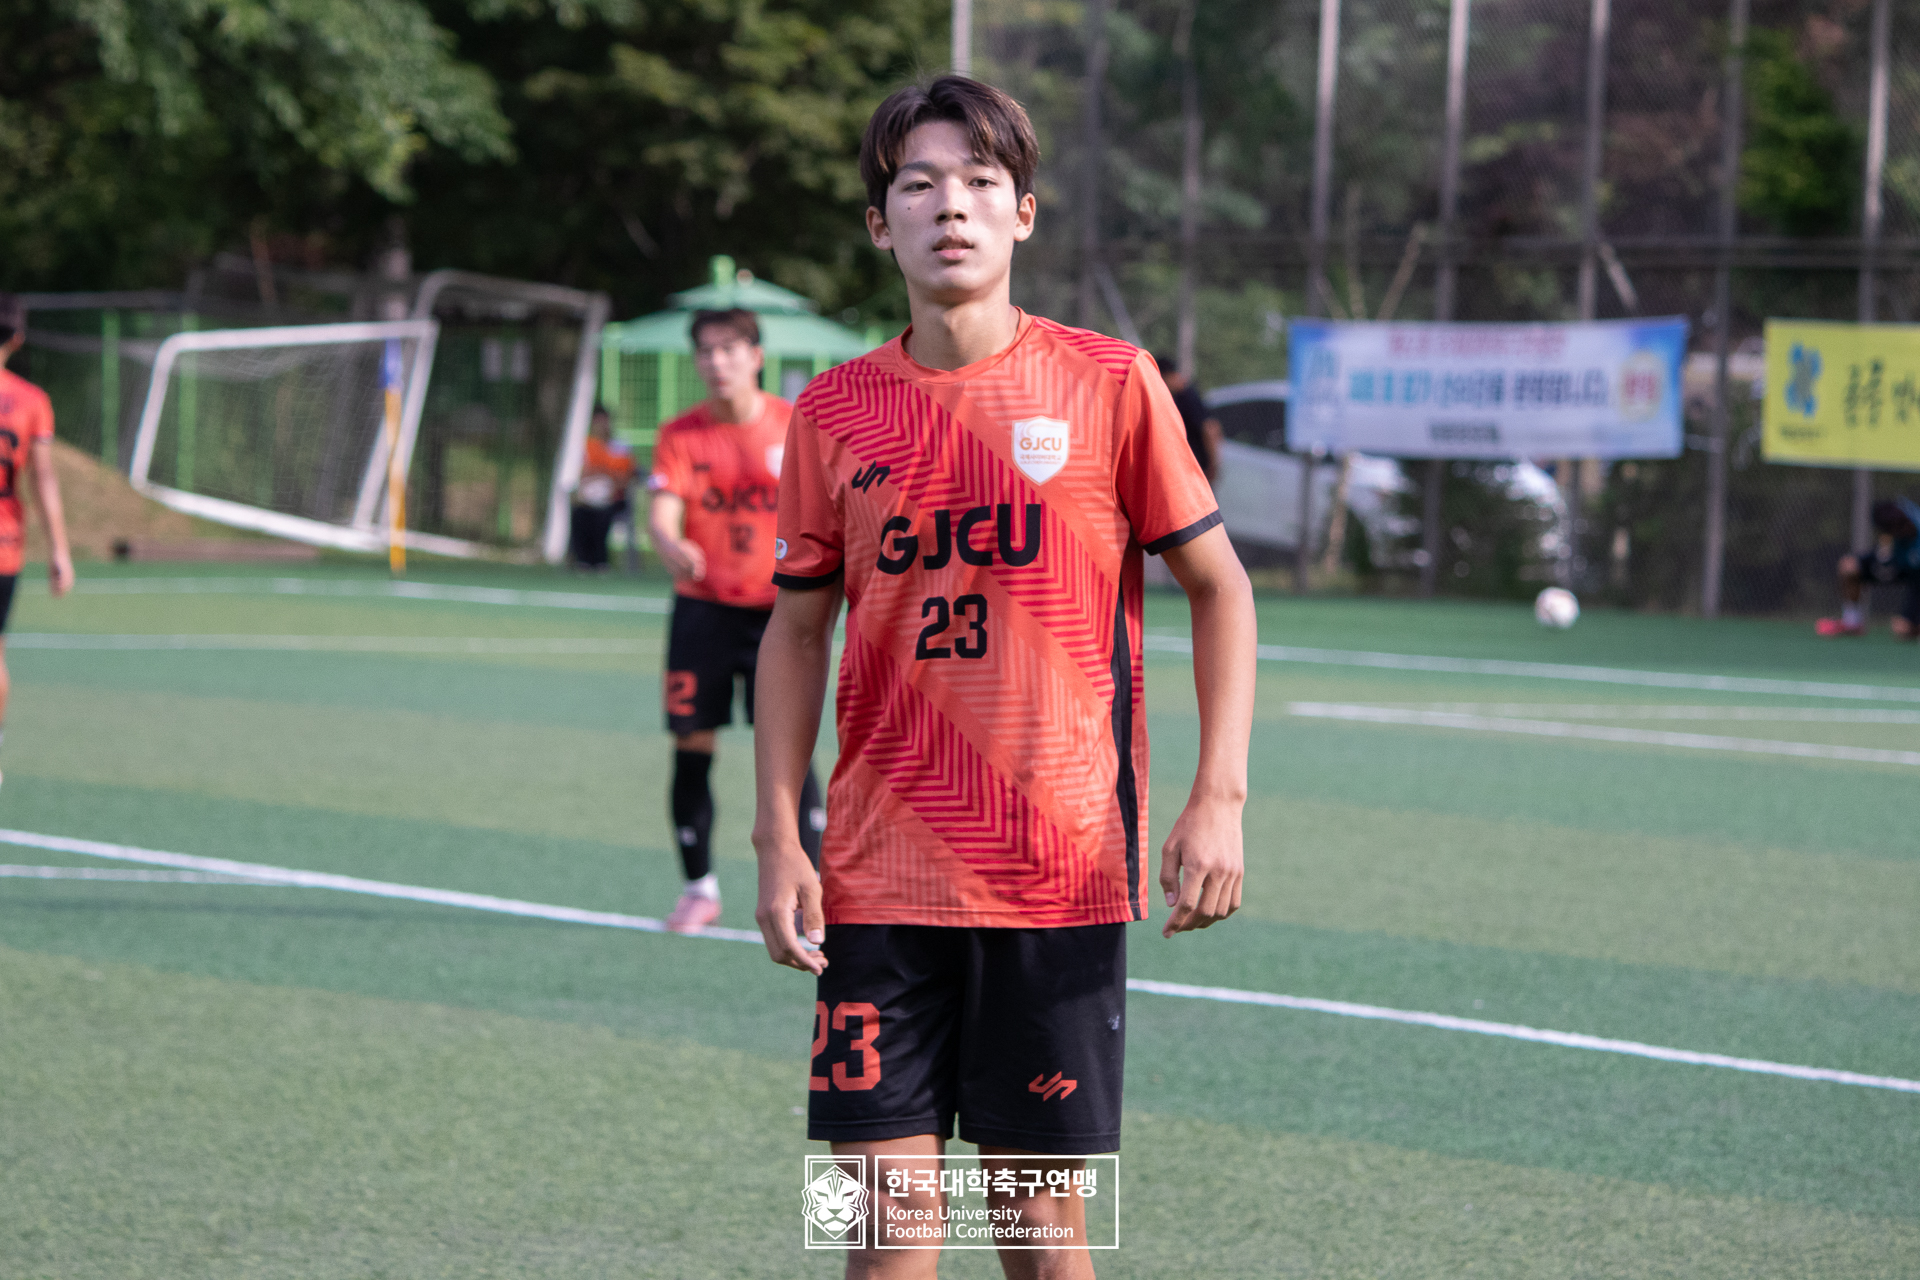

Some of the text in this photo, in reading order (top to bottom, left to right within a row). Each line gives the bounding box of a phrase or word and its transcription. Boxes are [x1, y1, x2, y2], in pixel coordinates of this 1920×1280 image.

[1020, 437, 1062, 451] GJCU
[876, 503, 1041, 575] GJCU
[915, 594, 988, 661] 23
